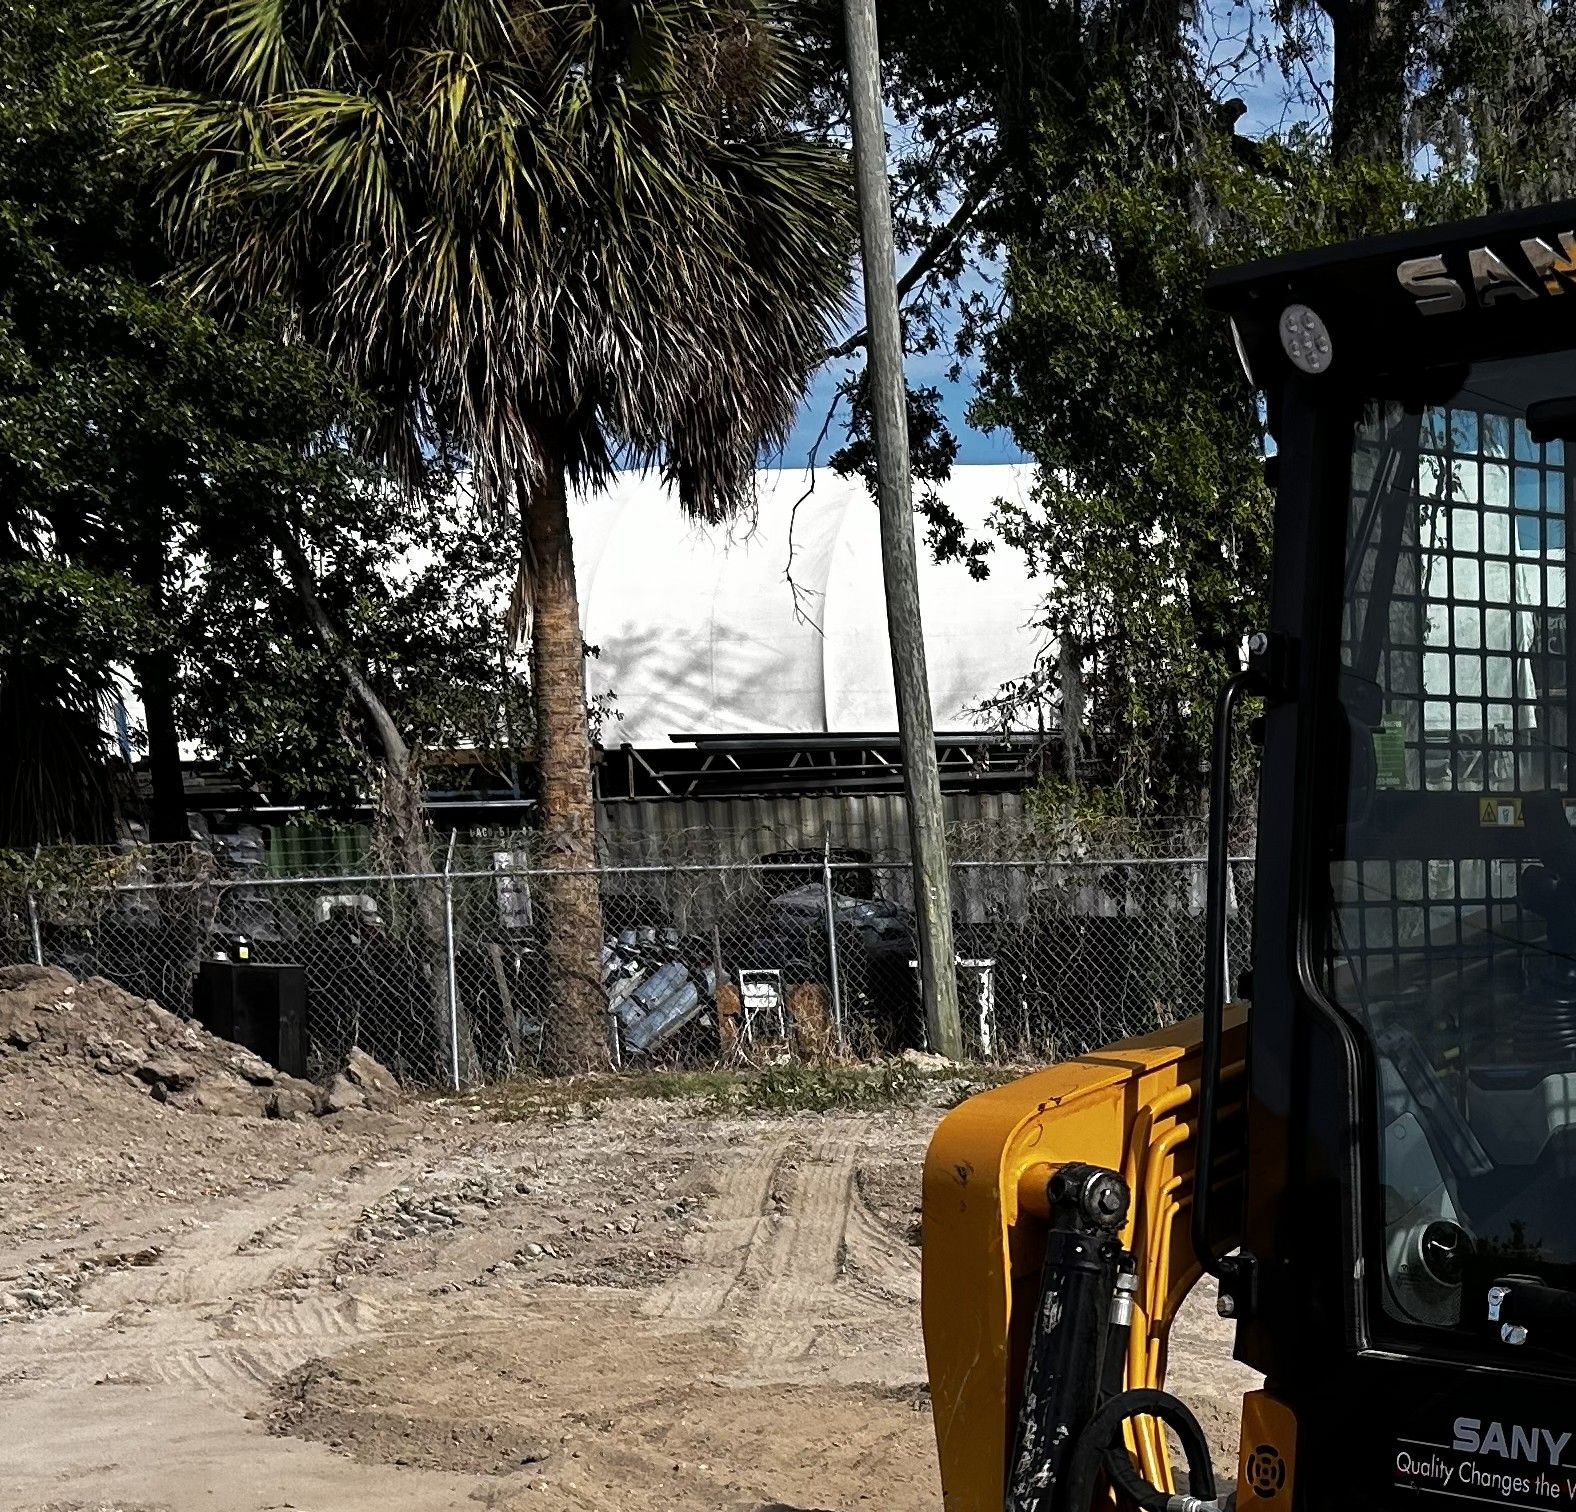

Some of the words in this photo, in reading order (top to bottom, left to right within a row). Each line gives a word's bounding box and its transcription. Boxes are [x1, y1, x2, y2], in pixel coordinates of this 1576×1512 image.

[1452, 1416, 1573, 1466] SANY
[1396, 1451, 1454, 1486] Quality
[1458, 1461, 1530, 1496] Changes
[1535, 1471, 1561, 1498] the
